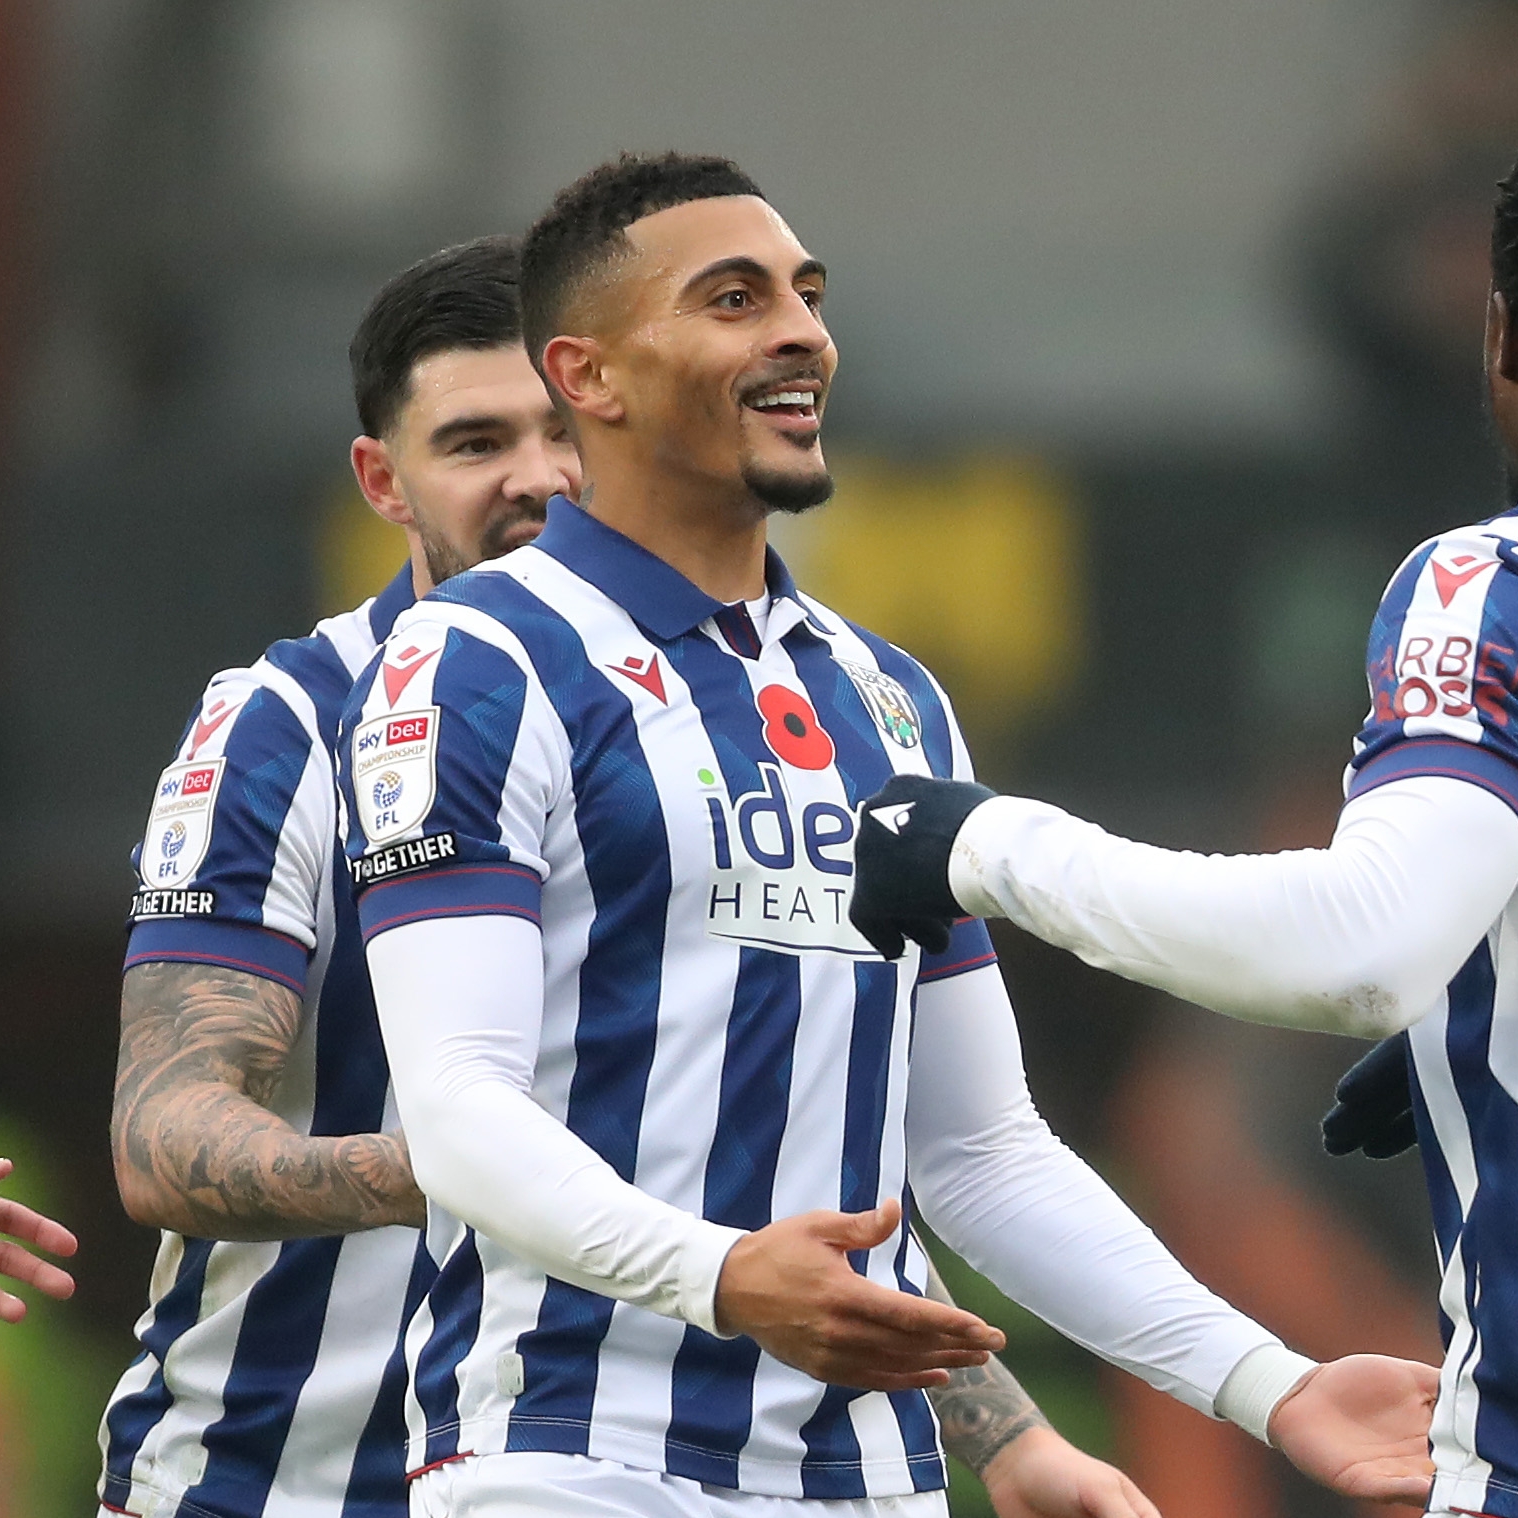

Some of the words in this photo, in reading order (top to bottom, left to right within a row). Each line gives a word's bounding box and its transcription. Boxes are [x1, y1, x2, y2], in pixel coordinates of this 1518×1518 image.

[358, 730, 384, 753] sky
[388, 720, 426, 741] bet
[358, 744, 427, 773] CHAMPIONSHIP
[160, 777, 183, 797] sky
[184, 772, 210, 790] bet
[376, 811, 400, 831] EFL
[697, 768, 854, 876] ide
[158, 864, 179, 878] EFL
[708, 882, 847, 924] HEAT
